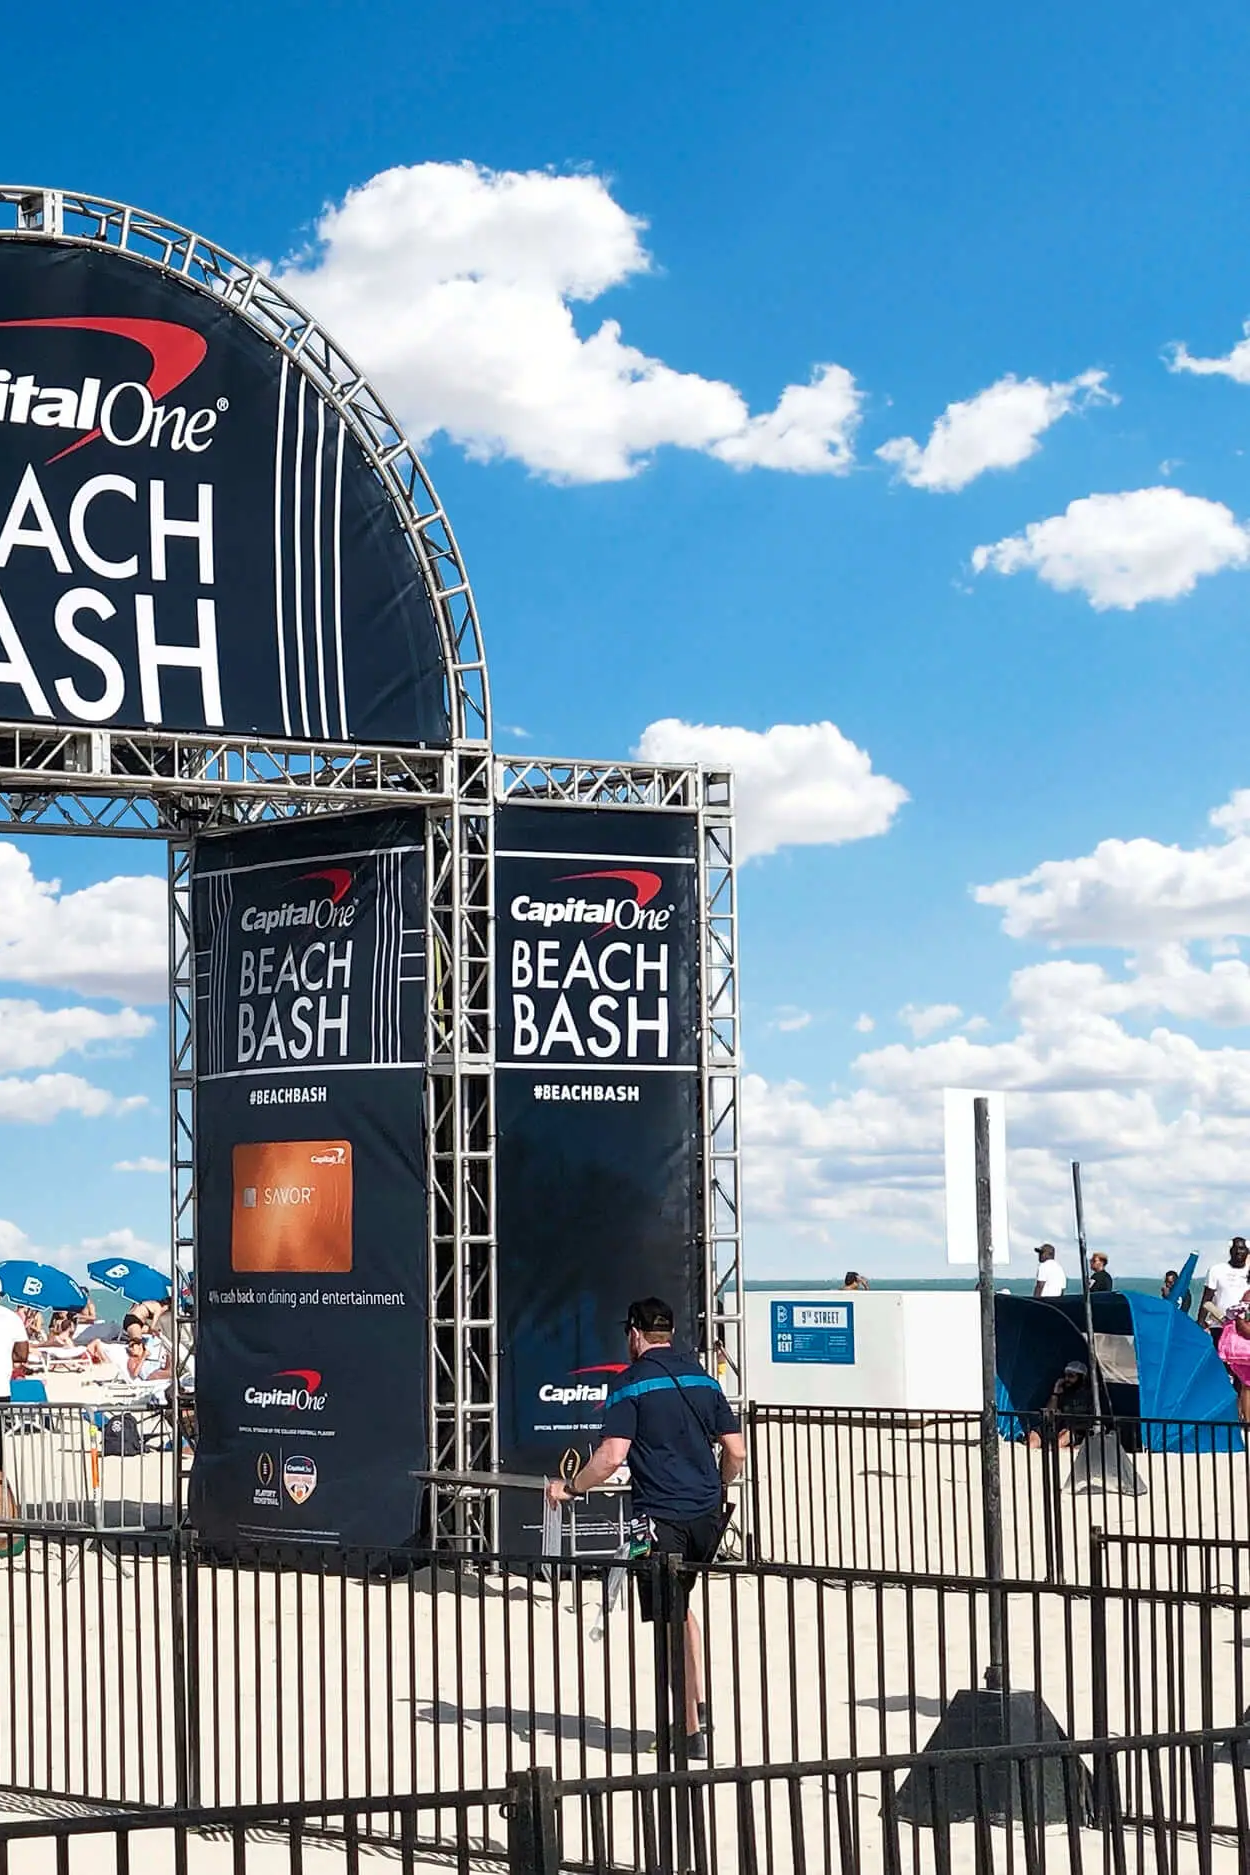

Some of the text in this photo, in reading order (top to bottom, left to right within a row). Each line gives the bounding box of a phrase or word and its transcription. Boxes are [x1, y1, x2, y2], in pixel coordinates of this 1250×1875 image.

[239, 939, 353, 997] BEACH
[512, 940, 668, 992] BEACH
[237, 994, 349, 1063] BASH
[512, 991, 669, 1058] BASH
[249, 1086, 327, 1105] #BEACHBASH
[533, 1084, 640, 1102] #BEACHBASH
[264, 1187, 311, 1205] SAVOR
[220, 1289, 236, 1304] cash
[236, 1288, 255, 1304] back
[255, 1291, 267, 1304] on
[268, 1289, 297, 1308] dining
[299, 1289, 319, 1305] and
[321, 1290, 406, 1306] entertainment
[813, 1311, 839, 1325] STREET
[777, 1333, 792, 1341] FOR
[538, 1383, 608, 1405] Capital
